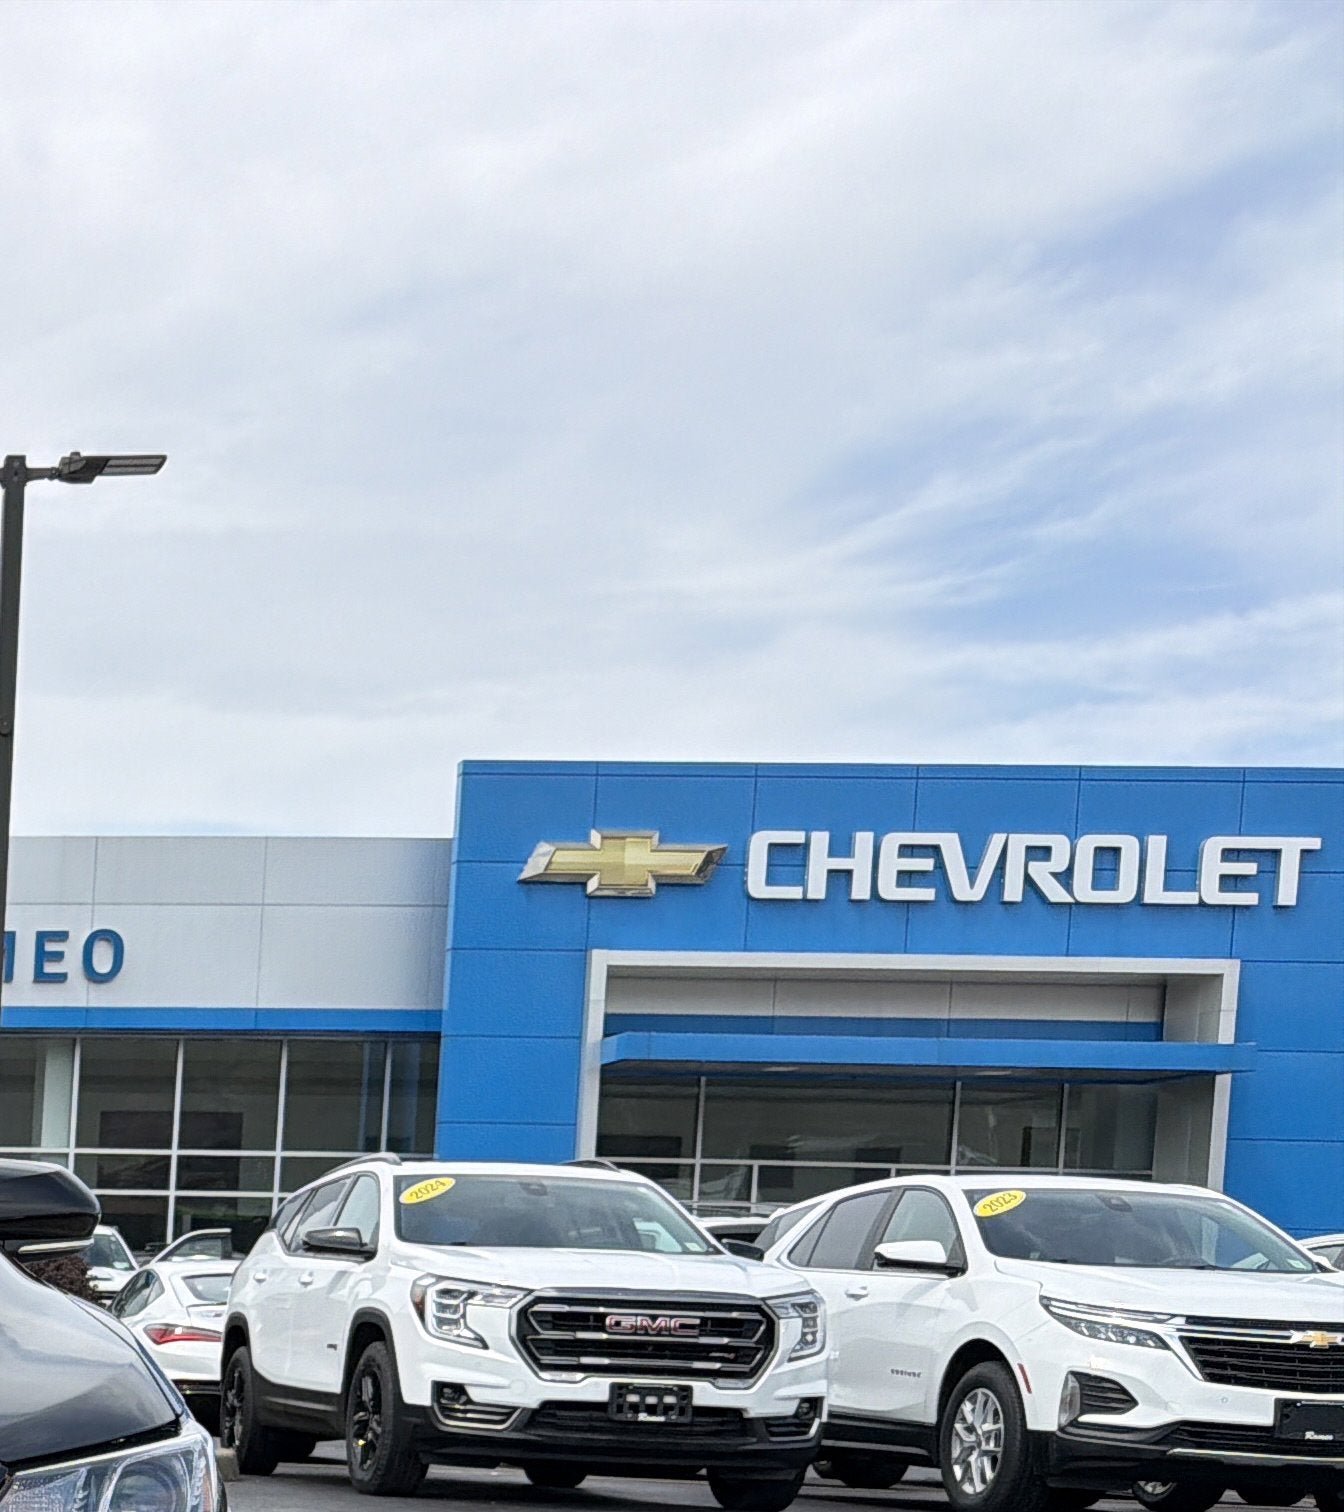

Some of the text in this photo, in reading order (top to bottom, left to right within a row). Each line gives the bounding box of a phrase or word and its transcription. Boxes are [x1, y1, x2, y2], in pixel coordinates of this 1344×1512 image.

[746, 830, 1322, 907] CHEVROLET
[409, 1180, 447, 1200] 2024
[982, 1192, 1018, 1213] 2023
[605, 1314, 701, 1336] GMC
